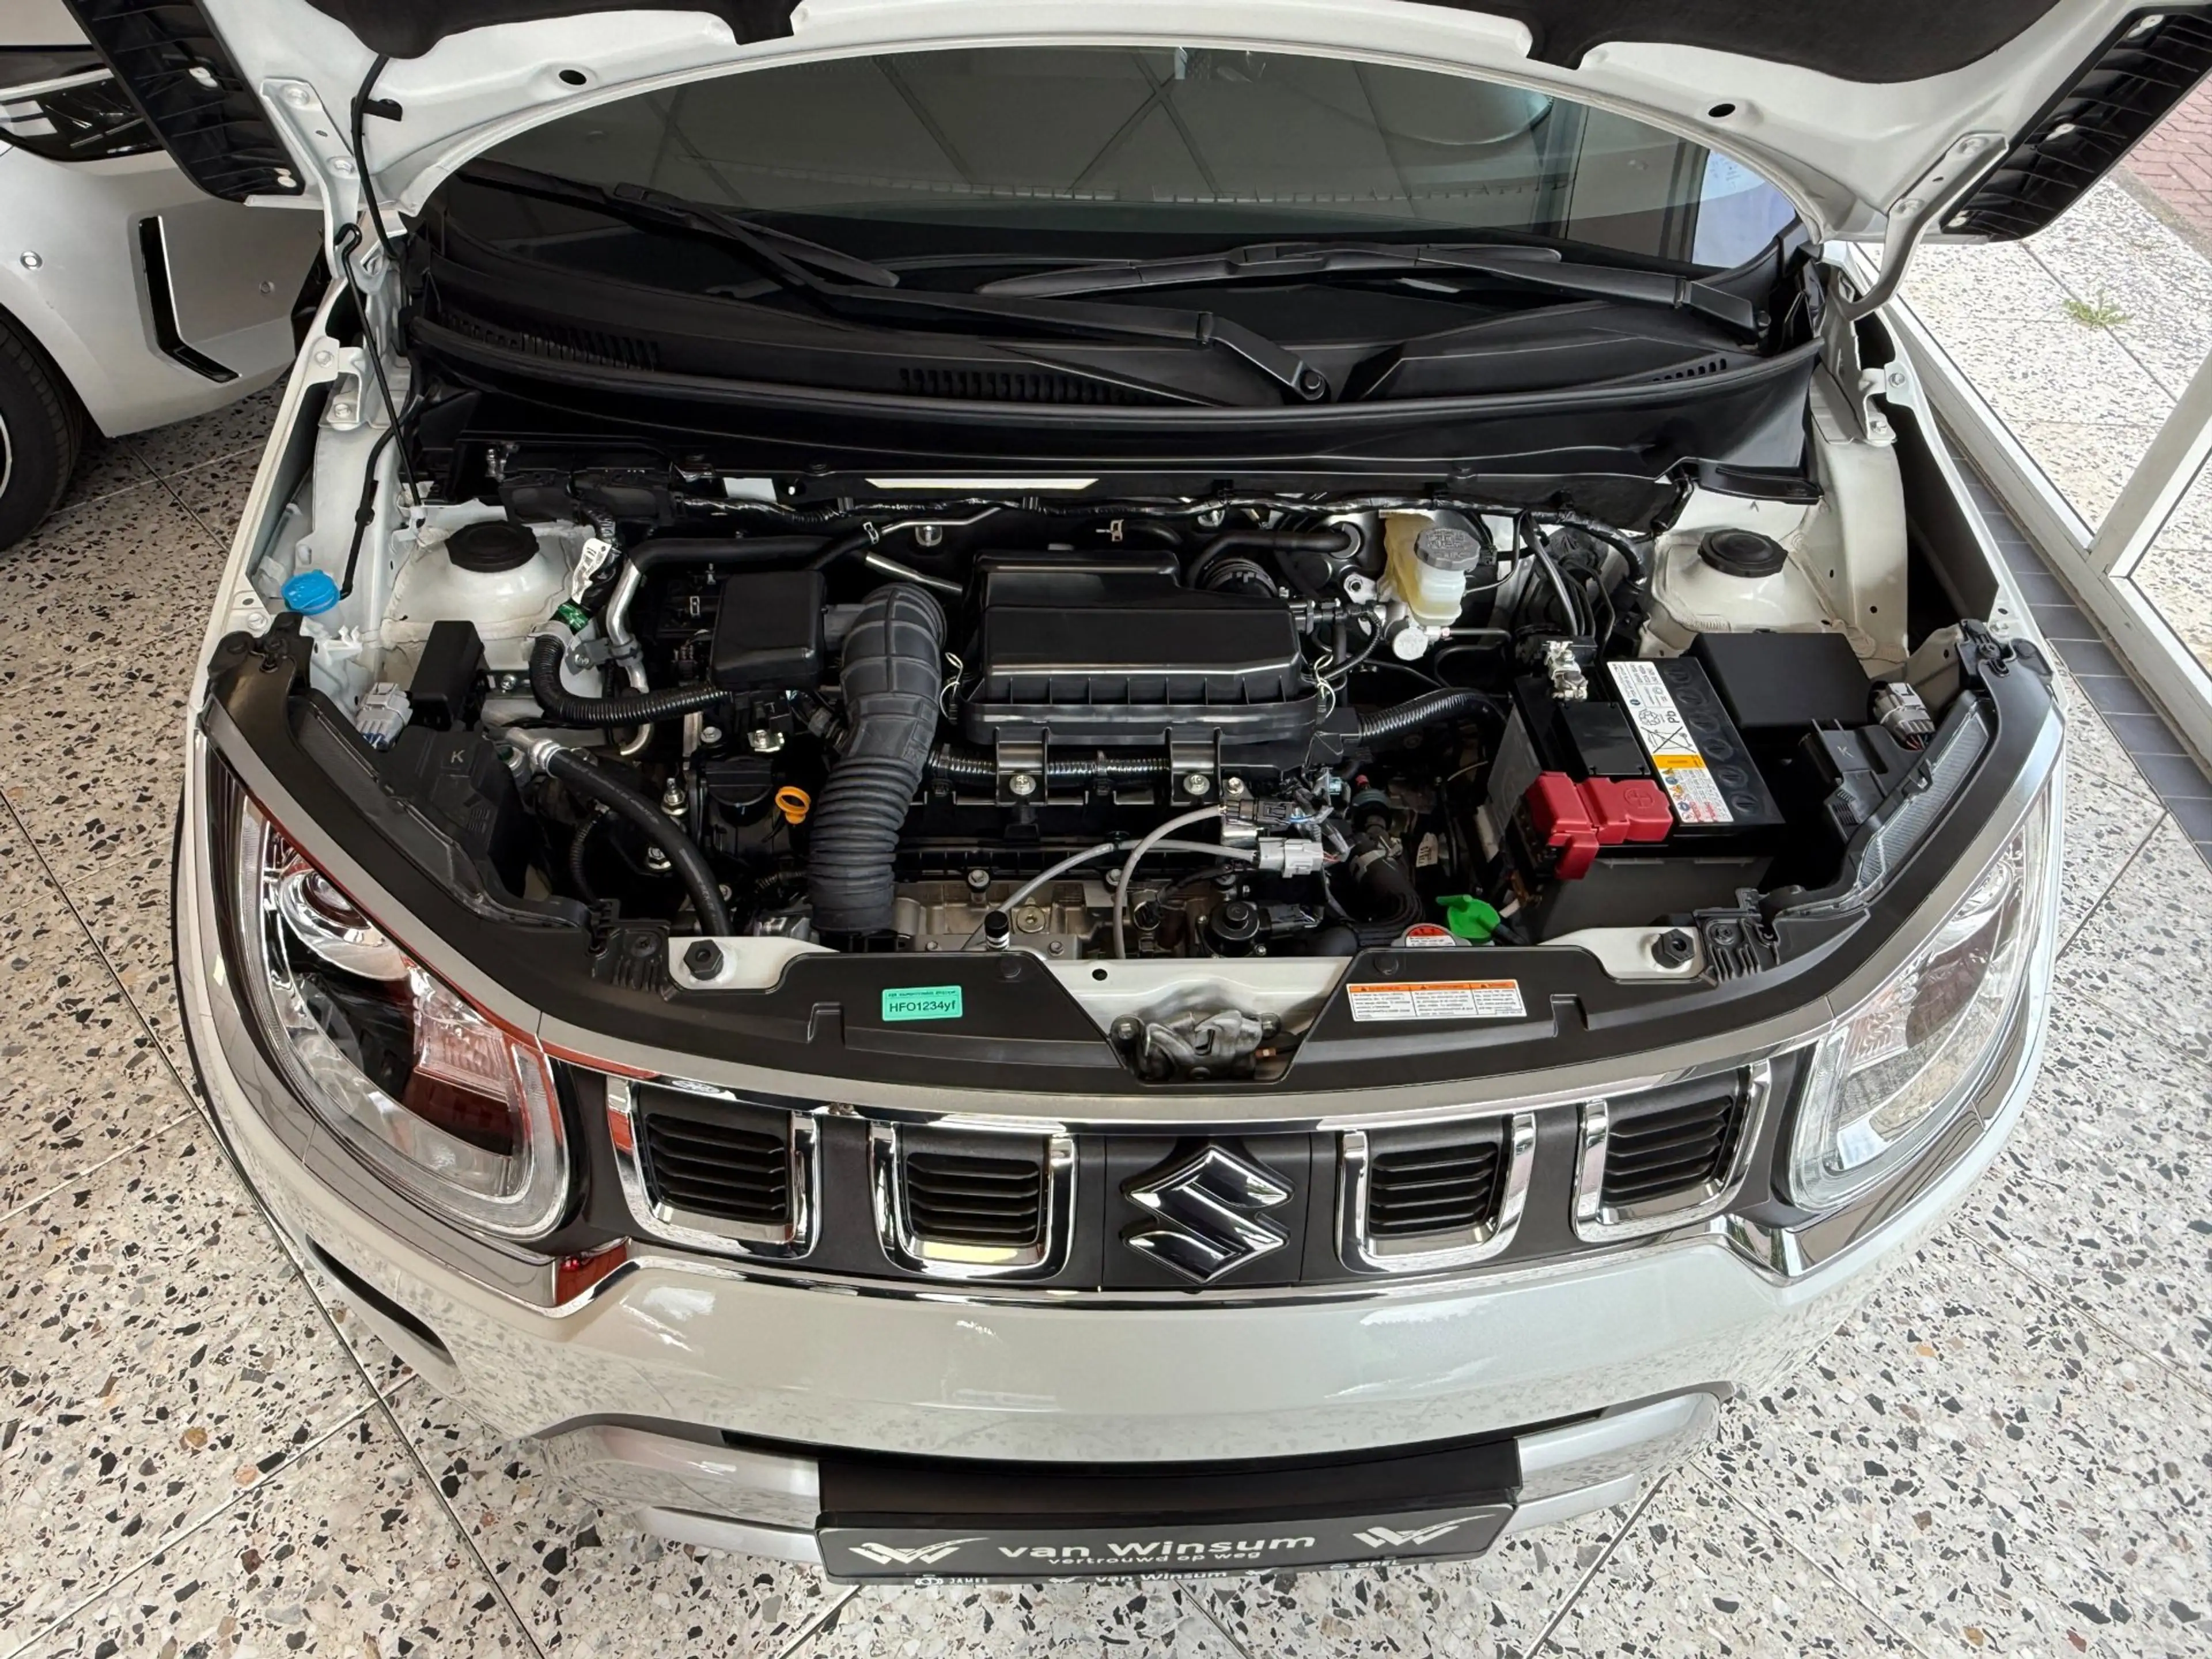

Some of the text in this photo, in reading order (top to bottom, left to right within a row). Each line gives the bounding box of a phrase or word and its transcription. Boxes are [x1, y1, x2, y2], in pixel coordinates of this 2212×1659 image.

[1665, 711, 1680, 723] Pb
[451, 749, 465, 763] K
[889, 1000, 956, 1012] HFO1234yf
[998, 1536, 1316, 1558] van Winsum
[1048, 1555, 1169, 1565] vertrouwd
[1214, 1551, 1260, 1560] weg
[1140, 1571, 1228, 1581] Winsum
